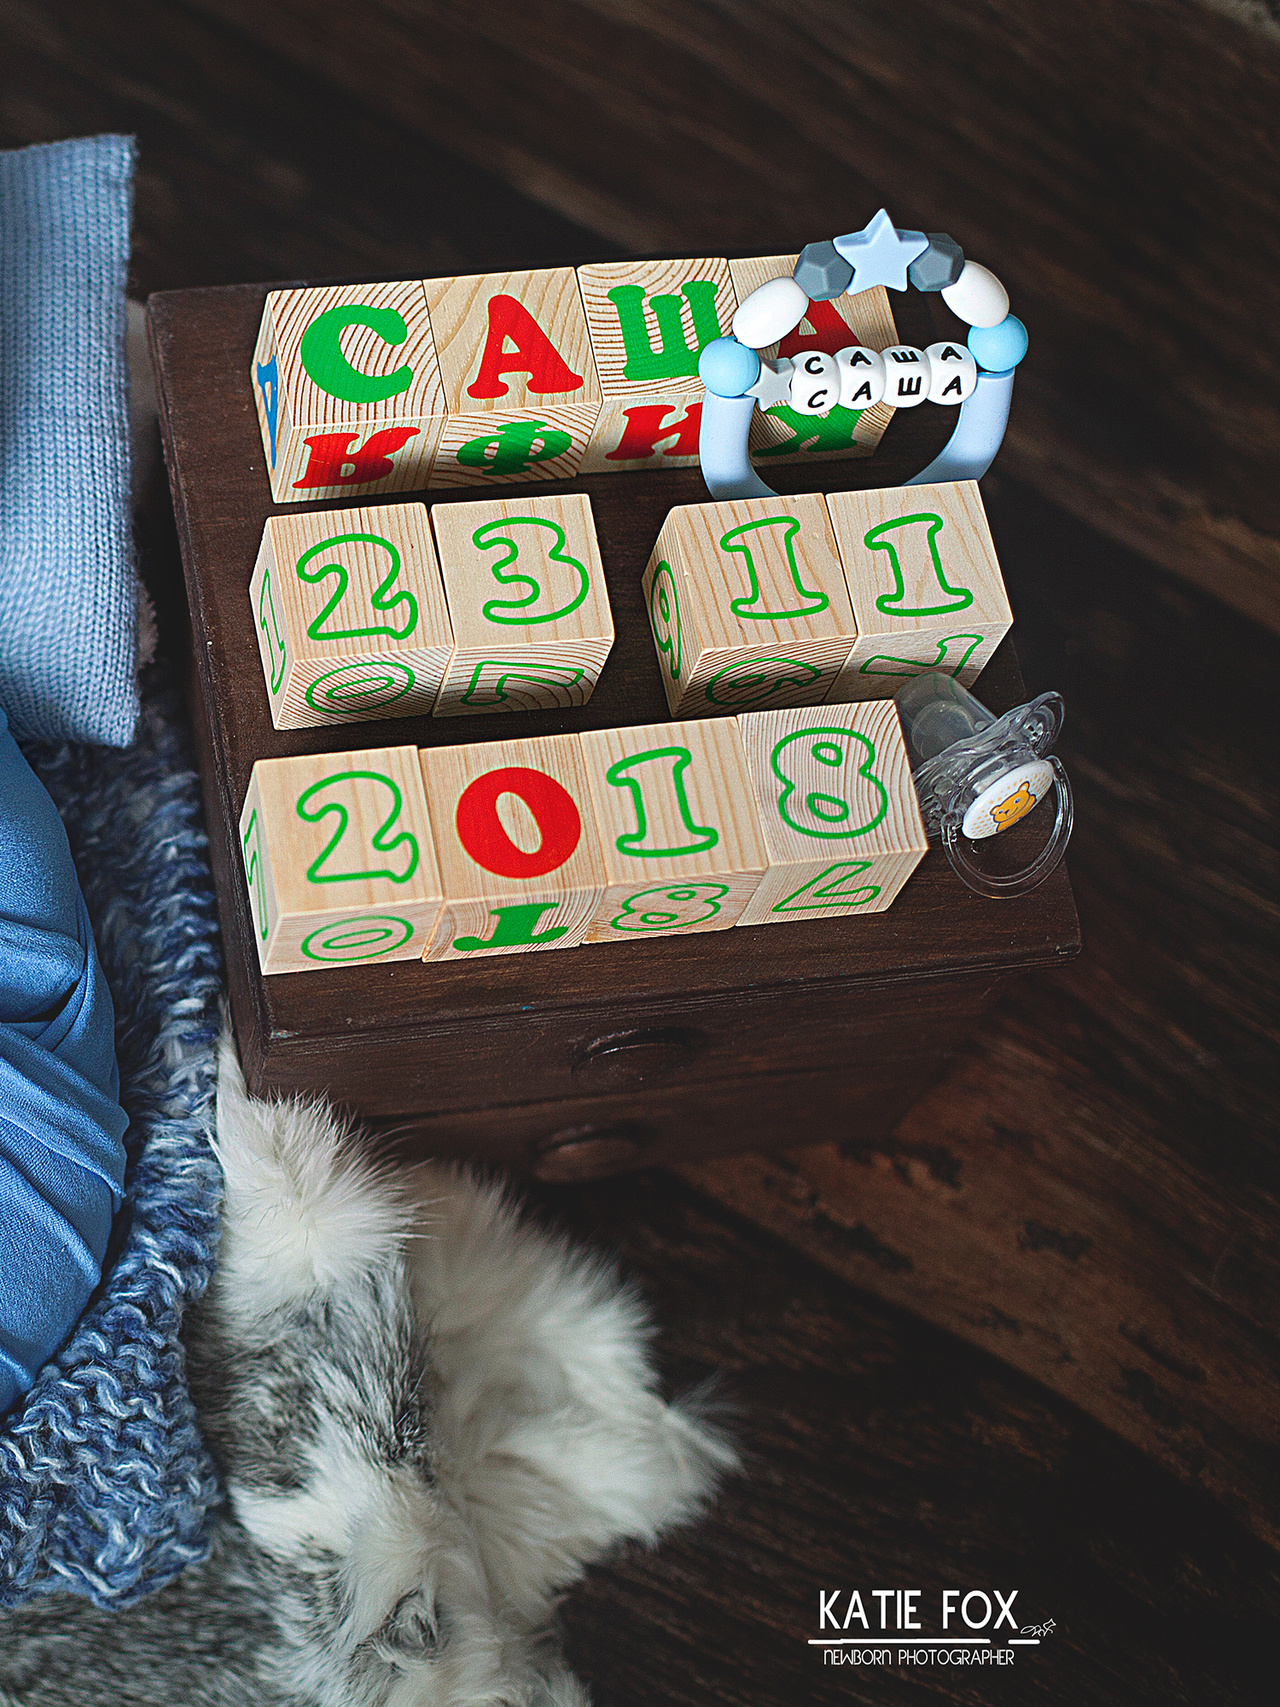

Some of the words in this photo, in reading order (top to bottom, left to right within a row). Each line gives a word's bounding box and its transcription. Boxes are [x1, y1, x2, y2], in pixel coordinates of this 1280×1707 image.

[803, 345, 963, 375] САША
[807, 375, 963, 409] САША
[295, 516, 590, 642] 23
[719, 512, 975, 620] 11
[295, 726, 890, 885] 2018
